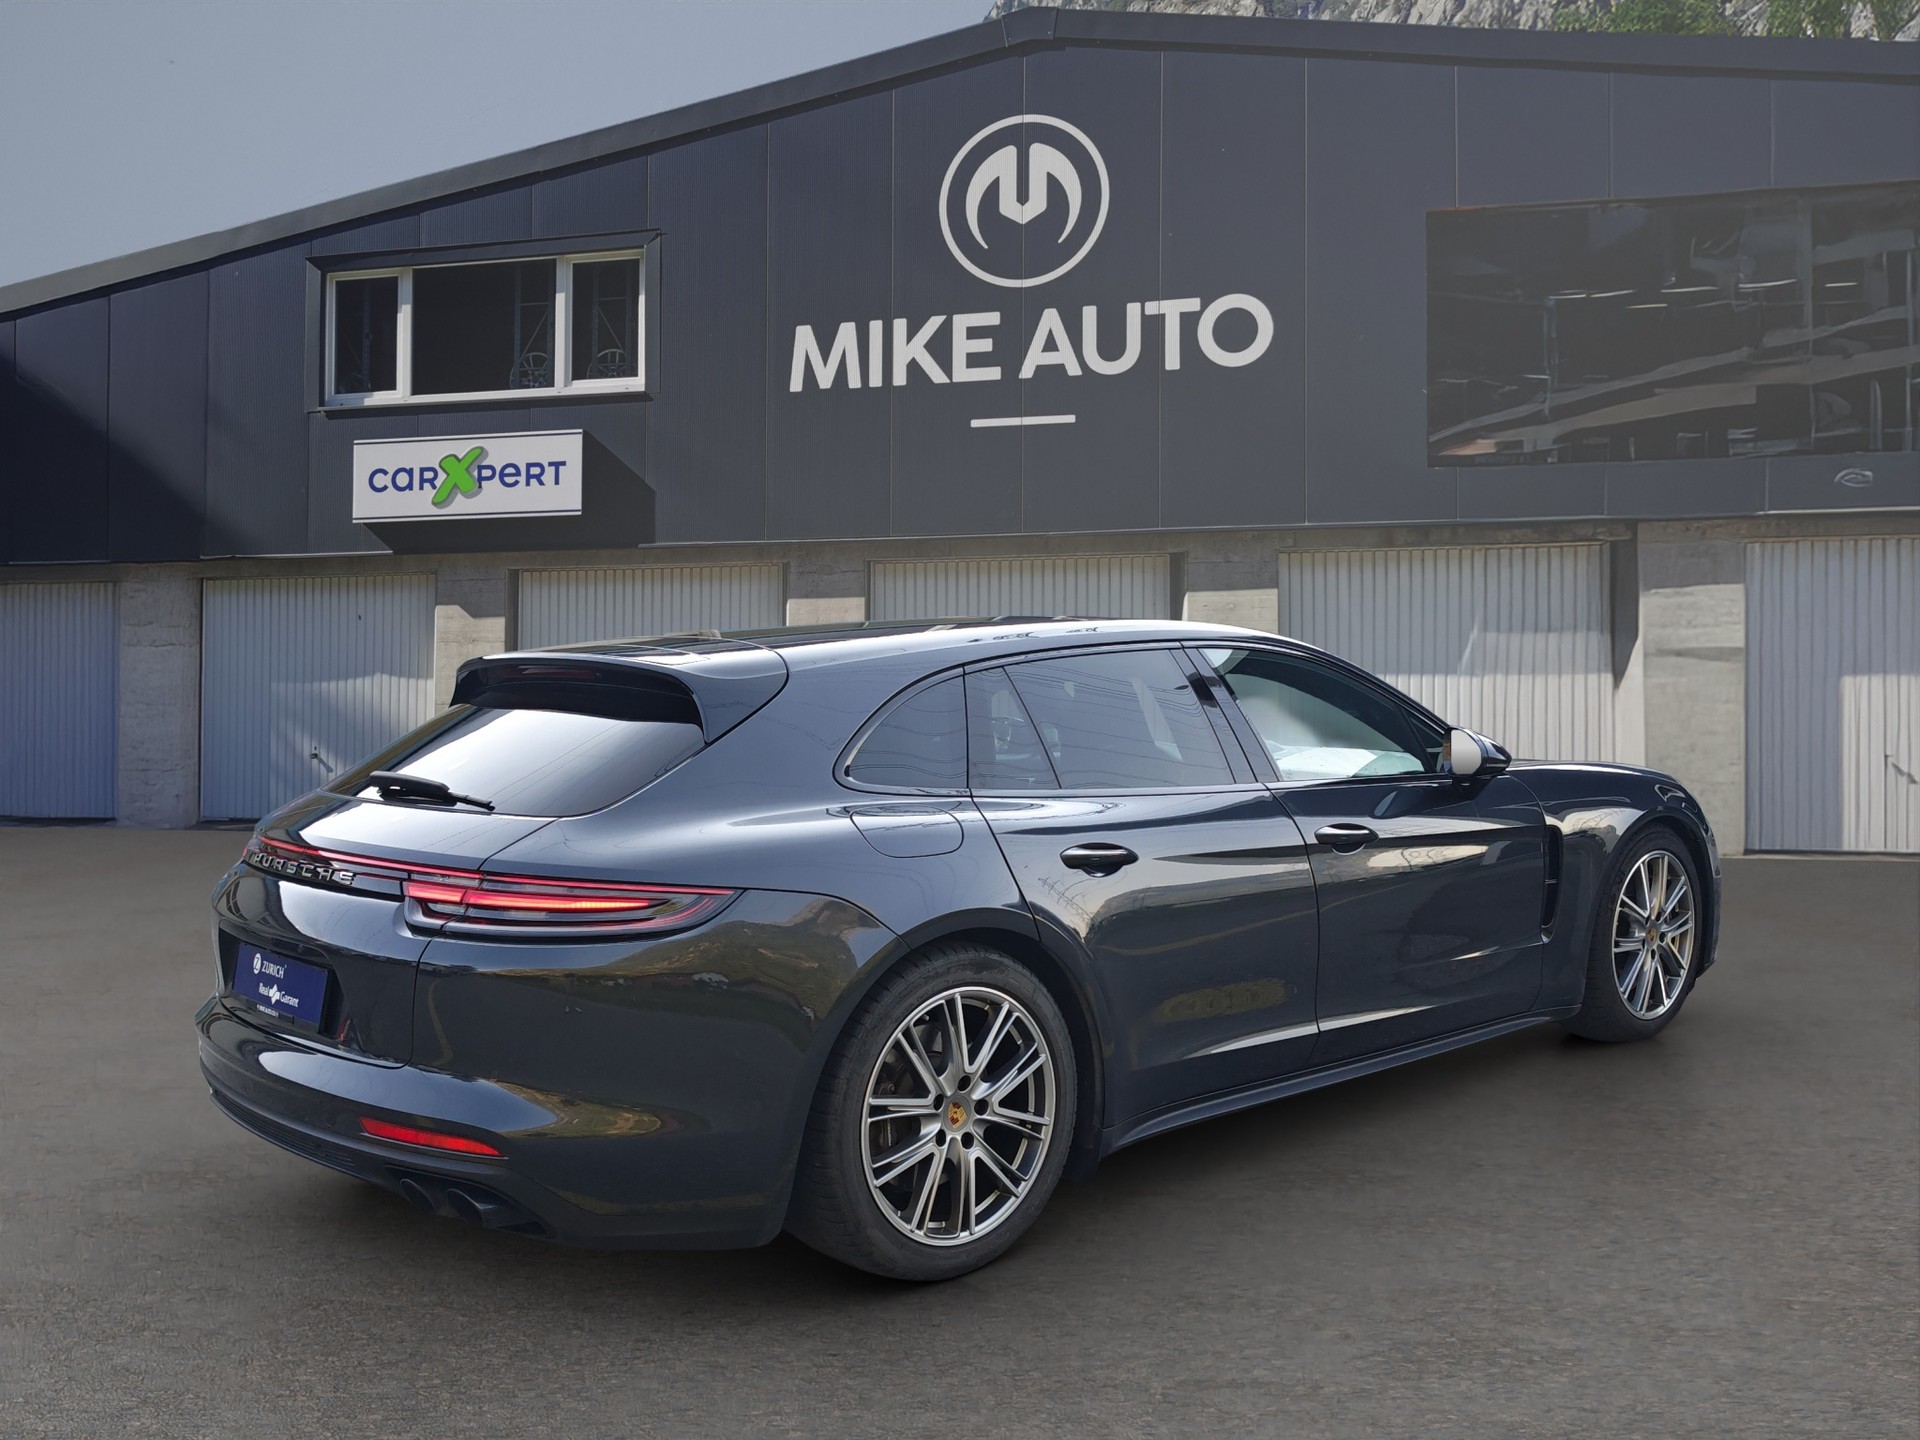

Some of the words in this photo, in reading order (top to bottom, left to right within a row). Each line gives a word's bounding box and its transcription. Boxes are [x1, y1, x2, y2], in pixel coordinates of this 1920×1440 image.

[789, 311, 1001, 392] MIKE
[1018, 293, 1274, 379] AUTO
[261, 960, 285, 979] ZURICH
[258, 982, 270, 996] Real
[280, 991, 300, 1008] Garant
